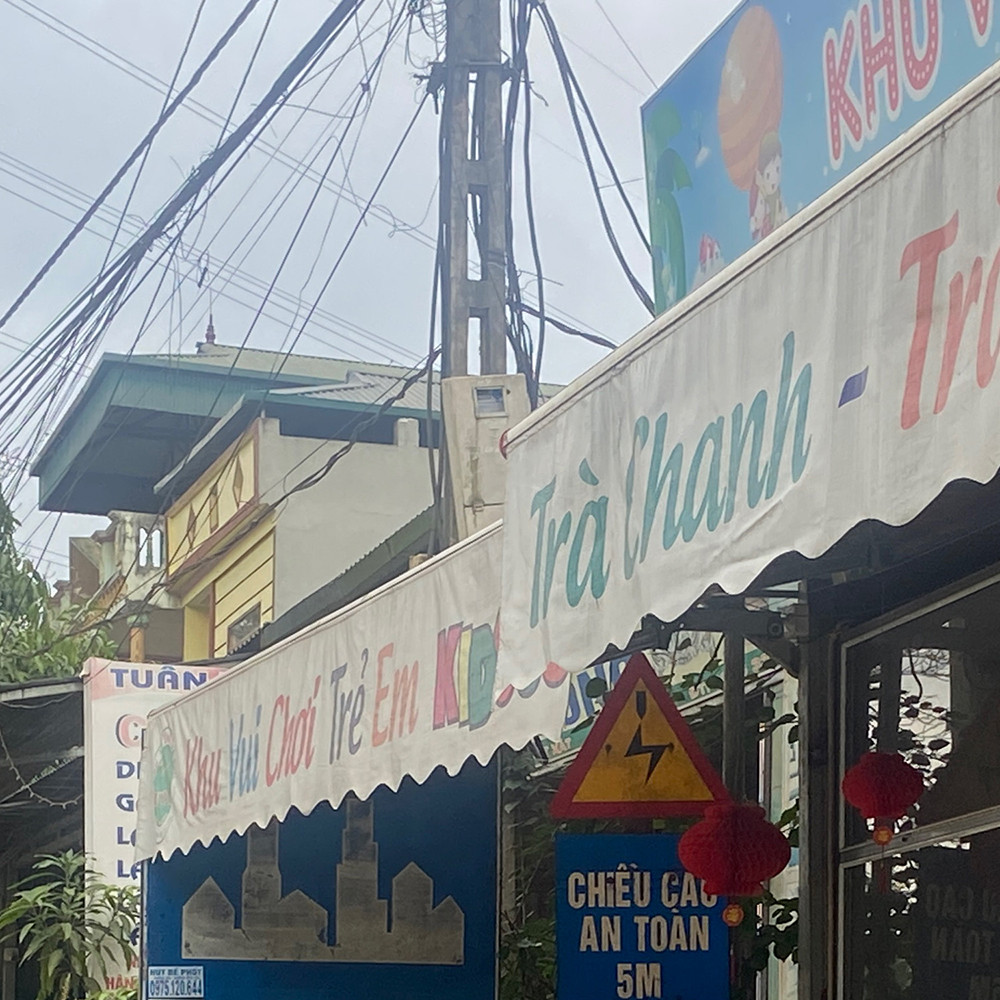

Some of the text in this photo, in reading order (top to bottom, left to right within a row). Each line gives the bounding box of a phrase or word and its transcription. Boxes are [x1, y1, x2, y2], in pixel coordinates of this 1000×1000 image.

[825, 0, 940, 161] KHU
[529, 456, 611, 628] Trà
[184, 735, 222, 819] Khu
[229, 704, 262, 802] Vui
[266, 675, 321, 788] Chơi
[329, 648, 369, 765] Trẻ
[371, 642, 420, 748] Em
[580, 908, 710, 952] AN TOÀN
[617, 963, 662, 999] 5M
